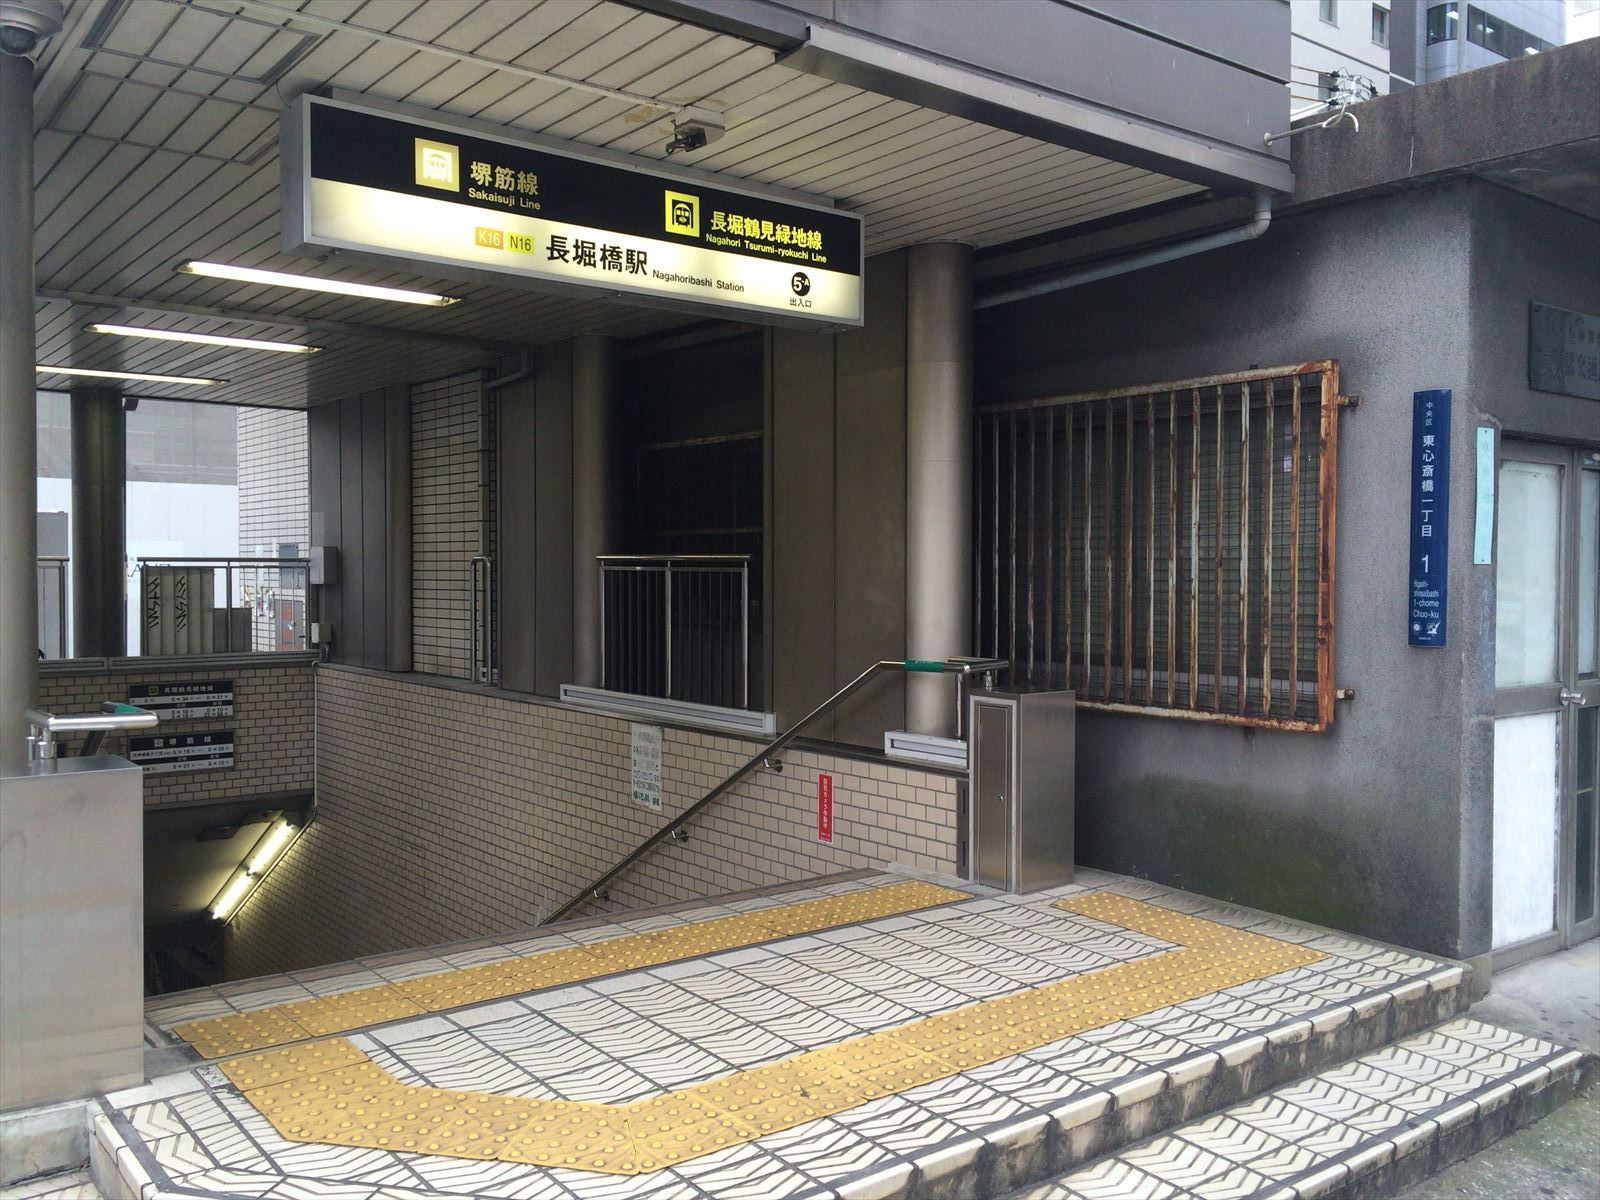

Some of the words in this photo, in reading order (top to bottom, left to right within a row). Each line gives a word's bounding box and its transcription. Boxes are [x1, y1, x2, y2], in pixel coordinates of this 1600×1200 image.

[470, 160, 539, 196] 堺筋線
[468, 187, 515, 207] Sakaisuji
[520, 198, 541, 211] Line
[710, 210, 823, 250] 長堀鶴見緑地線
[705, 233, 741, 248] Nagahori
[744, 240, 809, 260] Tsurumi-ryokuchi
[811, 252, 827, 263] Line
[478, 229, 500, 247] K16
[510, 235, 532, 252] N16
[546, 234, 648, 276] 長堀橋駅
[652, 269, 713, 287] Nagahoribashi
[716, 280, 745, 293] Station
[789, 297, 812, 308] 出入口
[1425, 401, 1434, 426] 中央区
[1421, 434, 1435, 537] 東心斎橋一丁目
[1421, 554, 1429, 574] 1
[1413, 599, 1440, 608] 1-chome
[1413, 609, 1440, 619] Chuo-ku
